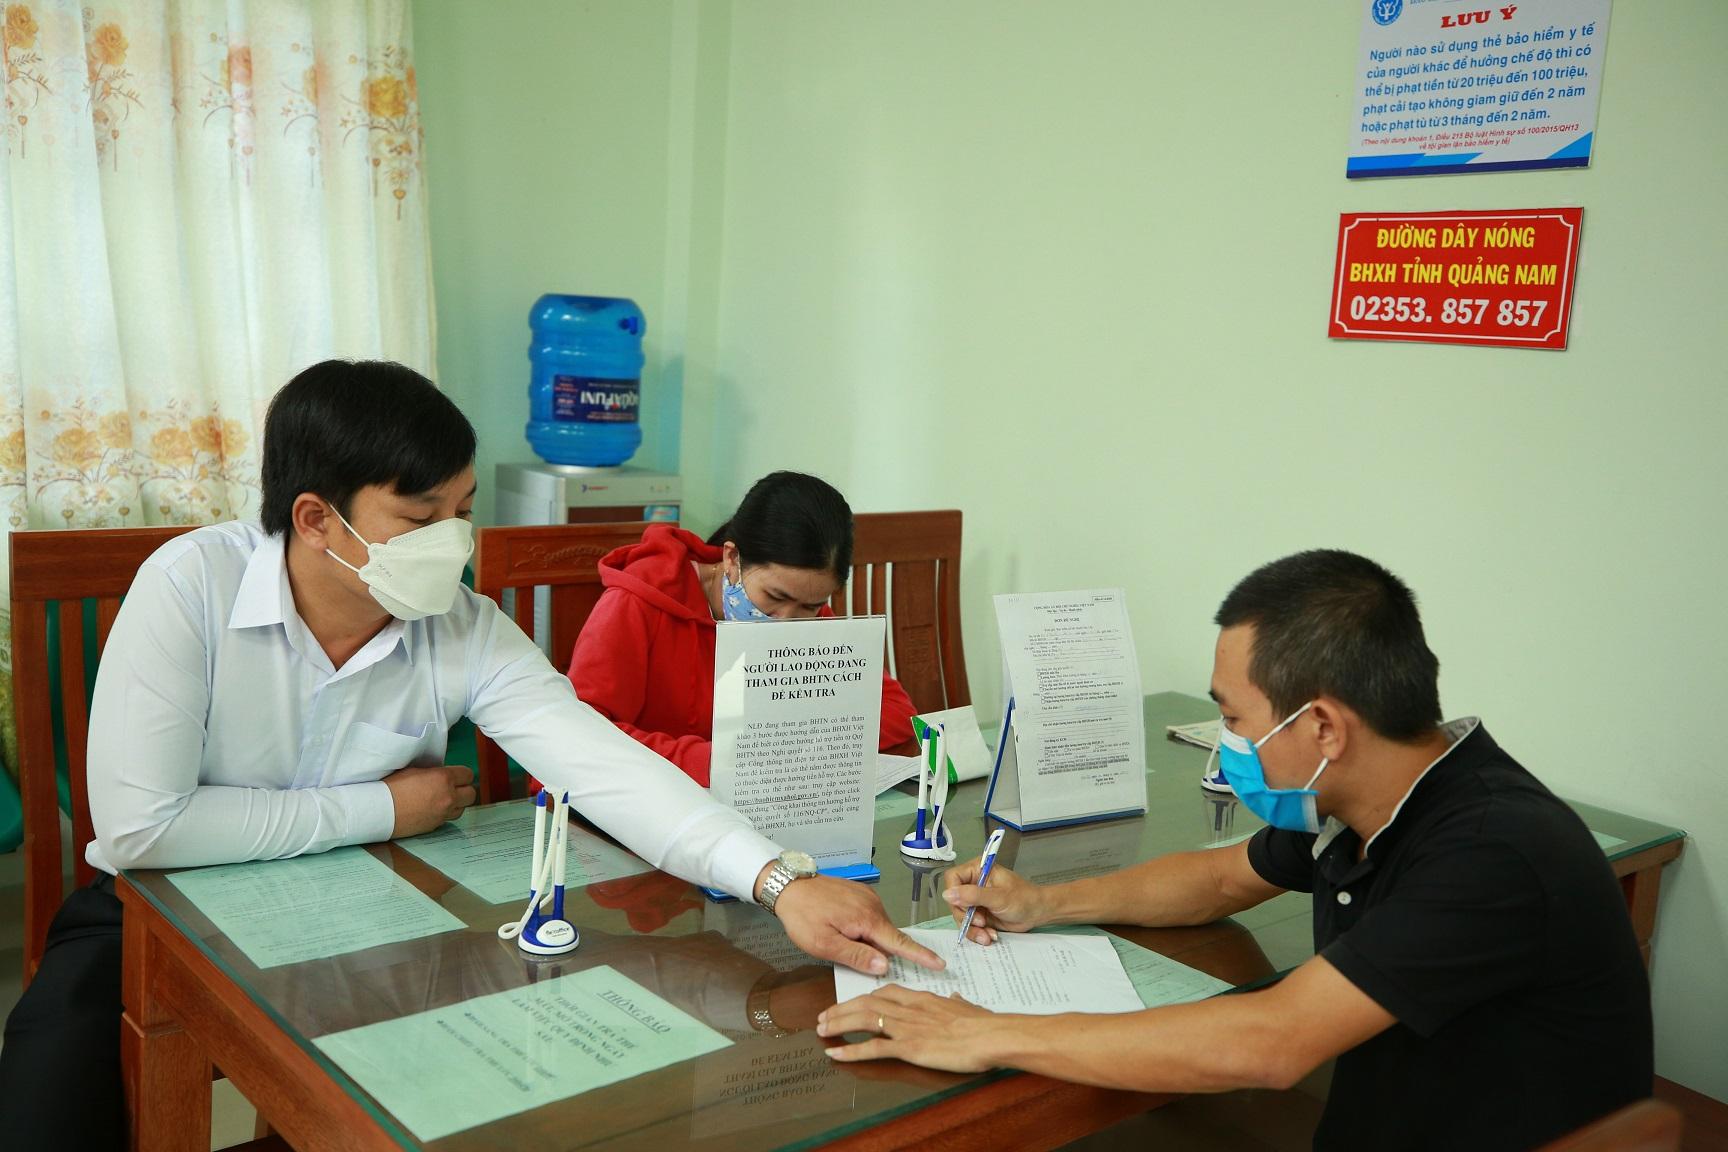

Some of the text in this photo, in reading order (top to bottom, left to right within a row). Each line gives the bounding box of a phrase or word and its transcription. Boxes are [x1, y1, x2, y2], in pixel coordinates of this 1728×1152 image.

[1500, 4, 1517, 20] Ý
[1370, 48, 1402, 62] Người
[1406, 45, 1426, 56] nào
[1449, 40, 1478, 52] dụng
[1483, 34, 1501, 47] thẻ
[1506, 32, 1528, 45] bảo
[1534, 26, 1564, 41] hiểm
[1570, 28, 1576, 40] y
[1582, 22, 1596, 36] tế
[1367, 66, 1385, 78] của
[1389, 63, 1419, 78] người
[1423, 62, 1449, 73] khác
[1453, 56, 1468, 69] để
[1471, 54, 1507, 68] hưởng
[1512, 50, 1534, 63] chế
[1537, 50, 1552, 62] độ
[1576, 44, 1591, 56] có
[1366, 82, 1383, 96] thể
[1385, 84, 1394, 97] bị
[1396, 83, 1421, 96] phạt
[1461, 77, 1474, 88] 20
[1476, 74, 1502, 87] triệu
[1506, 70, 1528, 83] đến
[1533, 68, 1552, 80] 100
[1363, 86, 1585, 116] phạt cải tạo không giam giữ đến 2 năm
[1361, 122, 1387, 133] hoặc
[1389, 120, 1414, 132] phạt
[1416, 119, 1426, 128] tù
[1442, 117, 1448, 126] 3
[1451, 112, 1483, 126] tháng
[1487, 110, 1508, 122] đến
[1512, 111, 1518, 120] 2
[1521, 109, 1550, 120] năm.
[1376, 222, 1535, 248] ĐƯỜNG DÂY NÓNG
[1350, 256, 1556, 287] BHXH TỈNH QUẢNG NAM
[1350, 295, 1547, 326] 02353. 857 857
[768, 646, 805, 658] THÔNG
[808, 645, 830, 656] BÁO
[745, 671, 862, 687] THAM GIA BHTN CÁCH
[780, 662, 801, 672] LAO
[805, 660, 834, 672] ĐỘNG
[815, 688, 835, 698] TRA
